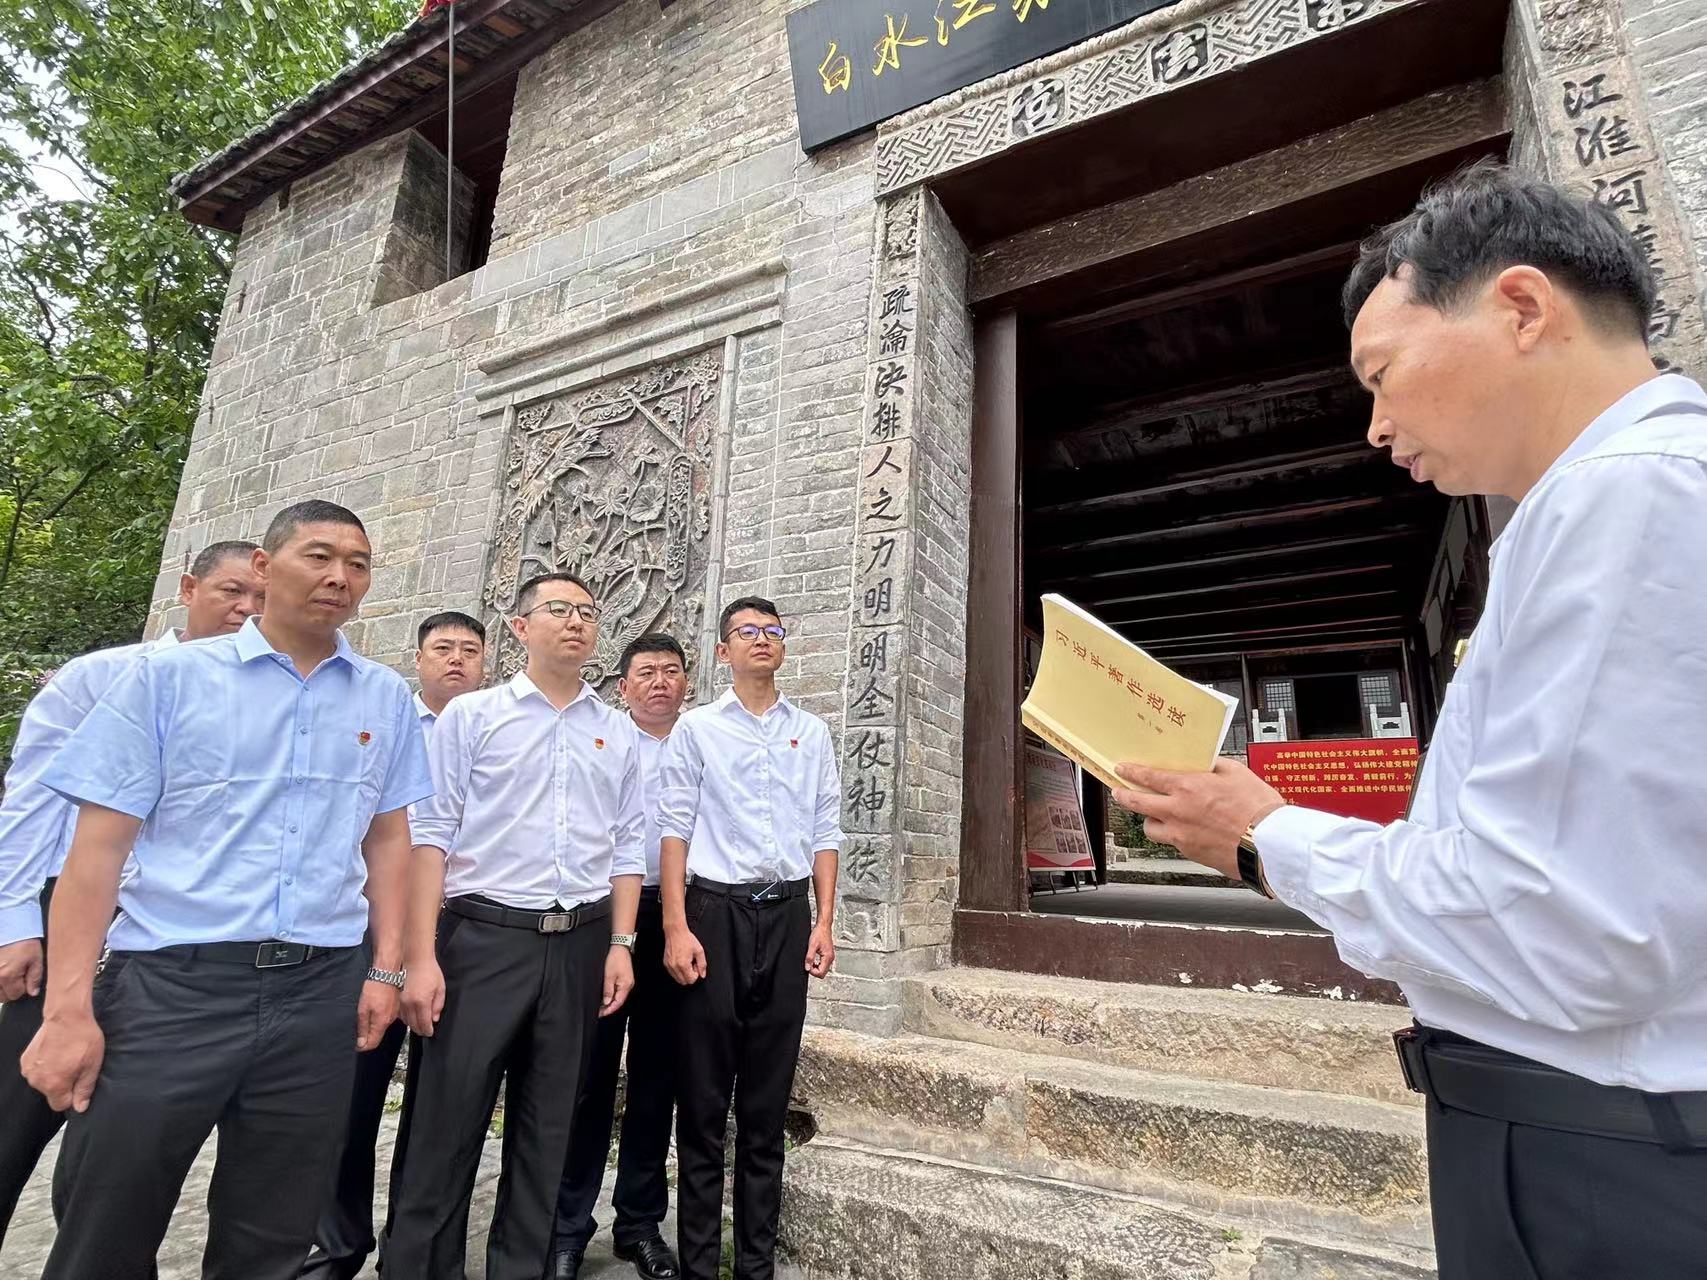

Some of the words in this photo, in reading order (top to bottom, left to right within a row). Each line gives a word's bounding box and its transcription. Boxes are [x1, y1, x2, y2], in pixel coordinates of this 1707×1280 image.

[1055, 628, 1187, 728] 习近平著作选读
